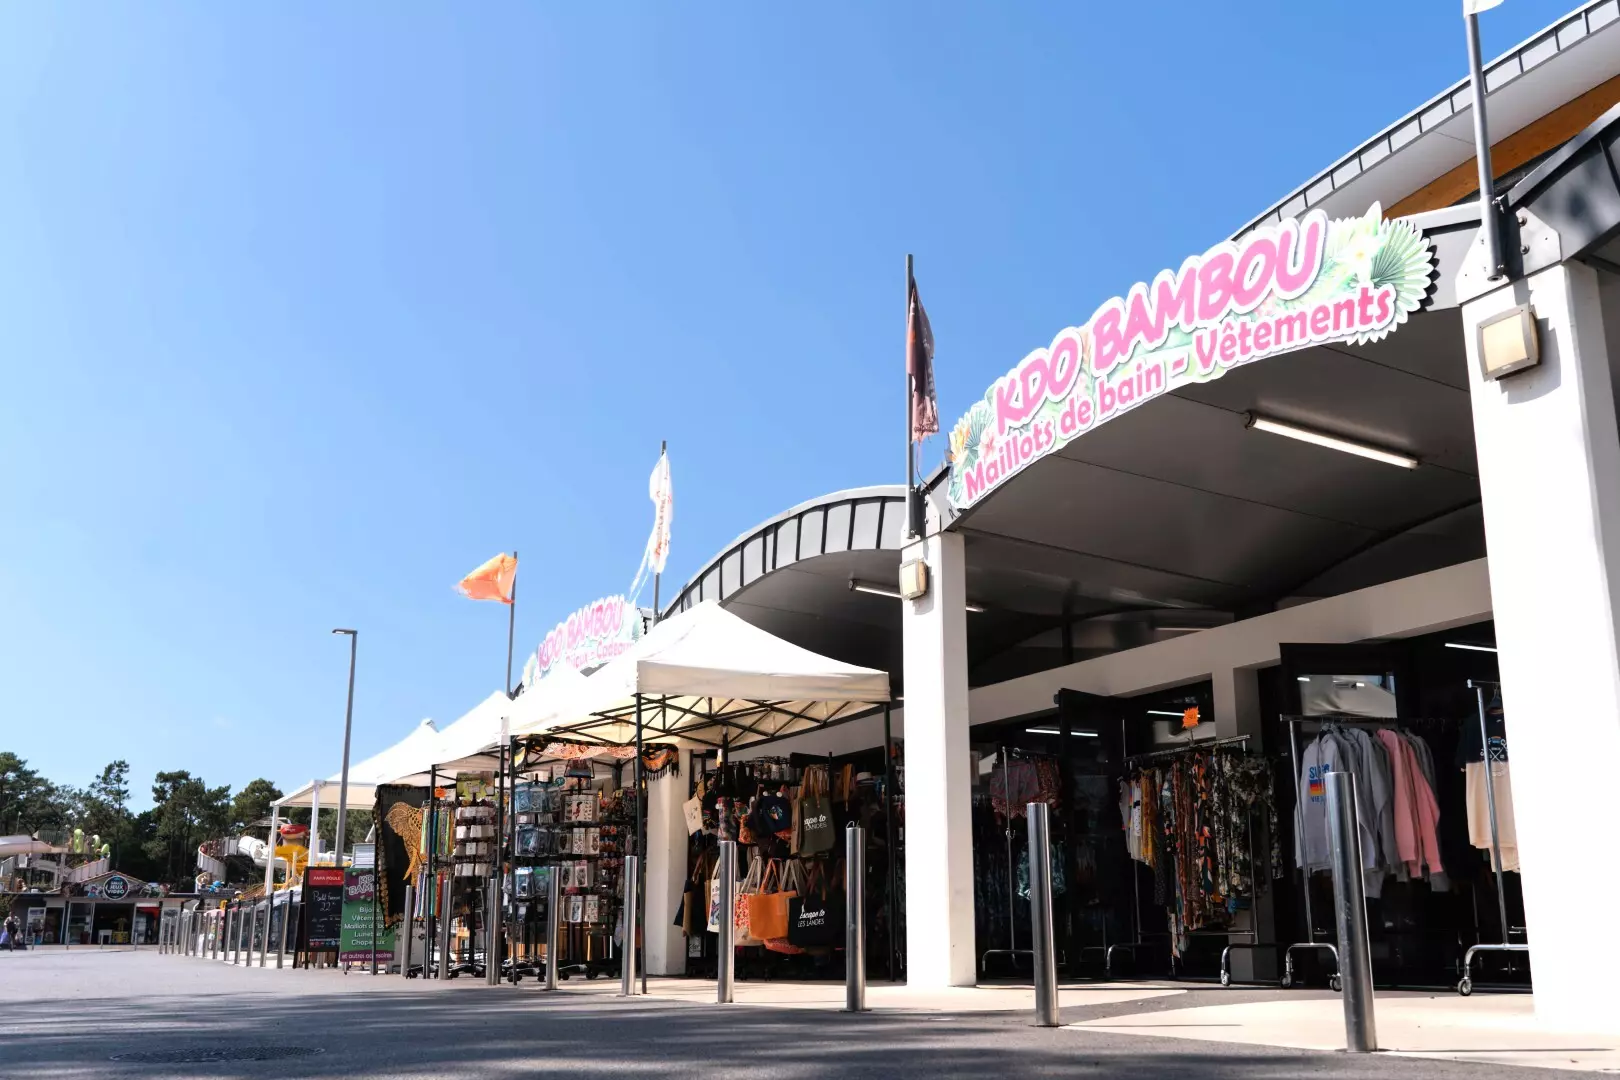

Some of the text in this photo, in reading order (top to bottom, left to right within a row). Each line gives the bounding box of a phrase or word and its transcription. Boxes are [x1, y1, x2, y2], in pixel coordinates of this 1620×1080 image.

[964, 418, 1054, 500] Maillots
[1060, 397, 1092, 434] de
[1098, 362, 1165, 415] bain
[1195, 286, 1392, 370] Vêtements
[996, 335, 1079, 435] KDO
[1092, 220, 1321, 371] BAMBOU
[566, 601, 624, 649] BAMBOU
